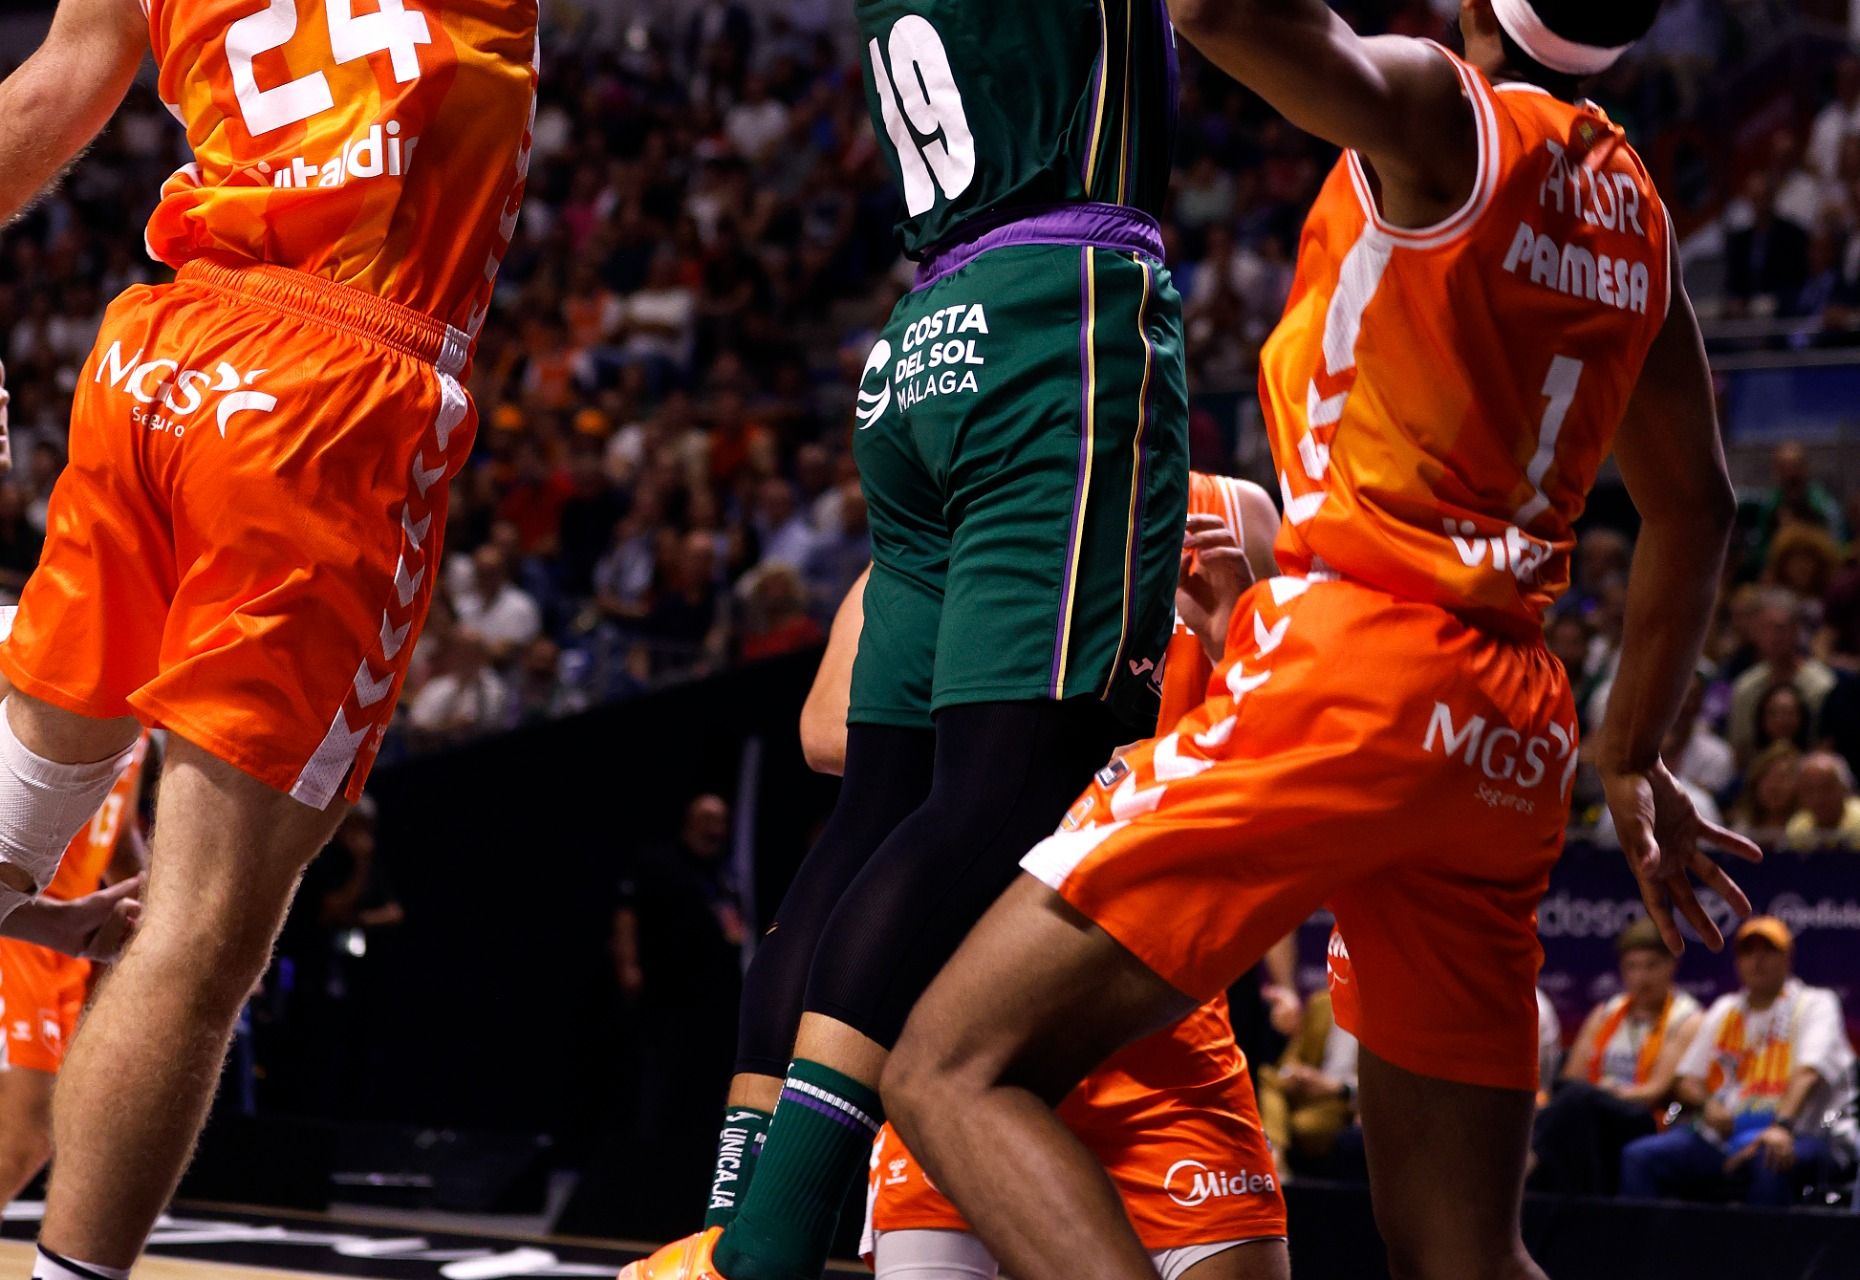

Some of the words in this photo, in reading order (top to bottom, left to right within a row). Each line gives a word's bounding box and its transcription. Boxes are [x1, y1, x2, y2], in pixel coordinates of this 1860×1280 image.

[868, 14, 976, 218] 19
[1503, 221, 1649, 315] PAMESA
[895, 350, 925, 384] DEL
[928, 340, 984, 367] SOL
[902, 304, 989, 353] COSTA
[95, 340, 212, 415] MGS
[896, 370, 978, 413] MÁLAGA
[1512, 354, 1584, 528] 1
[1422, 701, 1549, 788] MGS
[709, 1127, 749, 1209] UNICAJA
[1186, 1169, 1276, 1204] Midea
